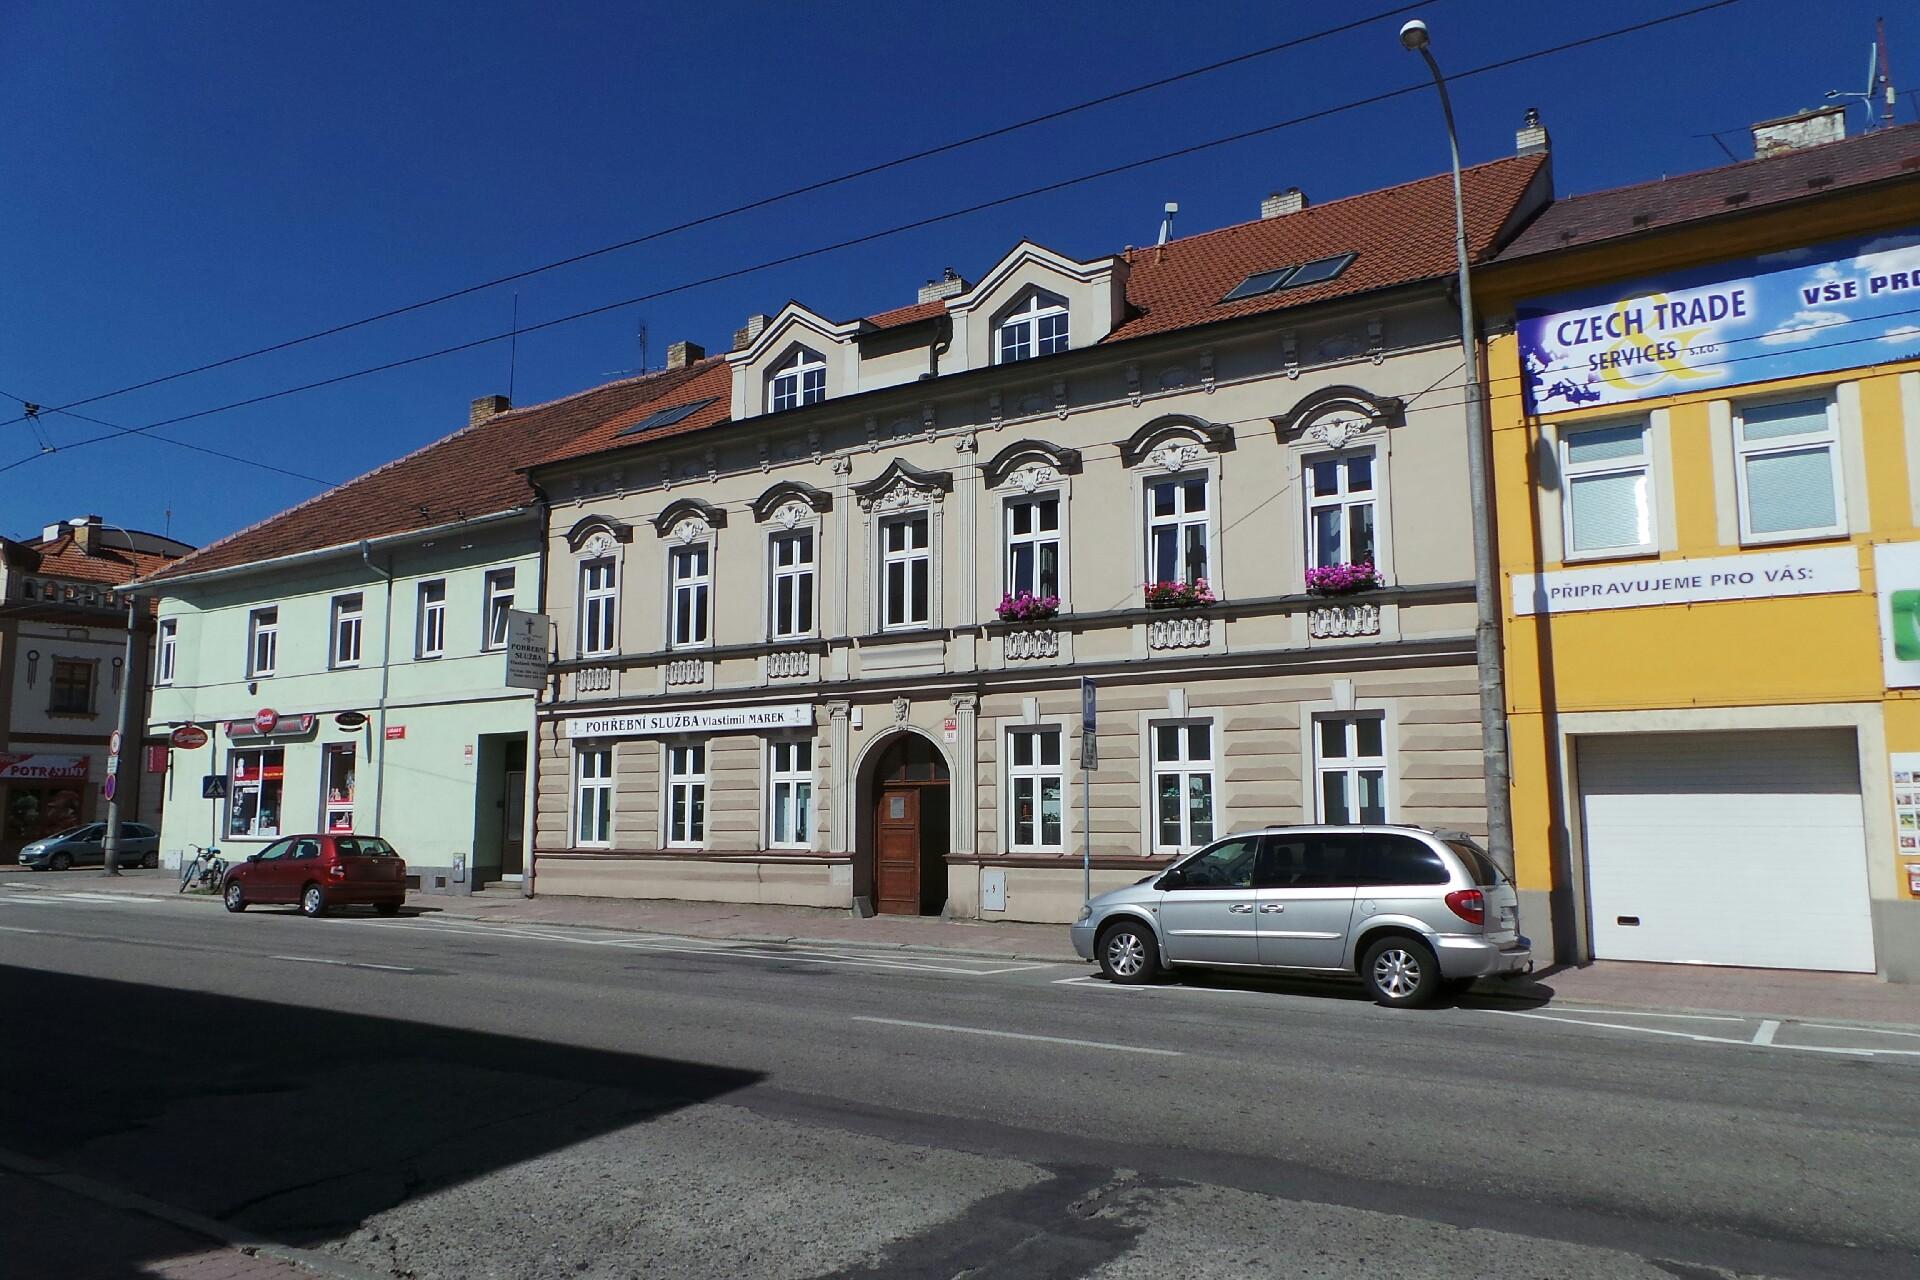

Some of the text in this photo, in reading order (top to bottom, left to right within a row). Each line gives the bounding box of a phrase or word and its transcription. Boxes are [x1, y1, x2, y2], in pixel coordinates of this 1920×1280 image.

[1803, 281, 1857, 305] VŠE
[1557, 290, 1746, 347] CZECH TRADE
[1589, 341, 1676, 371] SERVICES
[1551, 564, 1813, 599] PŘIPRAVUJEME PRO VÁS:
[586, 712, 784, 733] POHŘEBNÍ SLUŽBA Vlastimil MAREK
[10, 765, 87, 777] POTRAVINY
